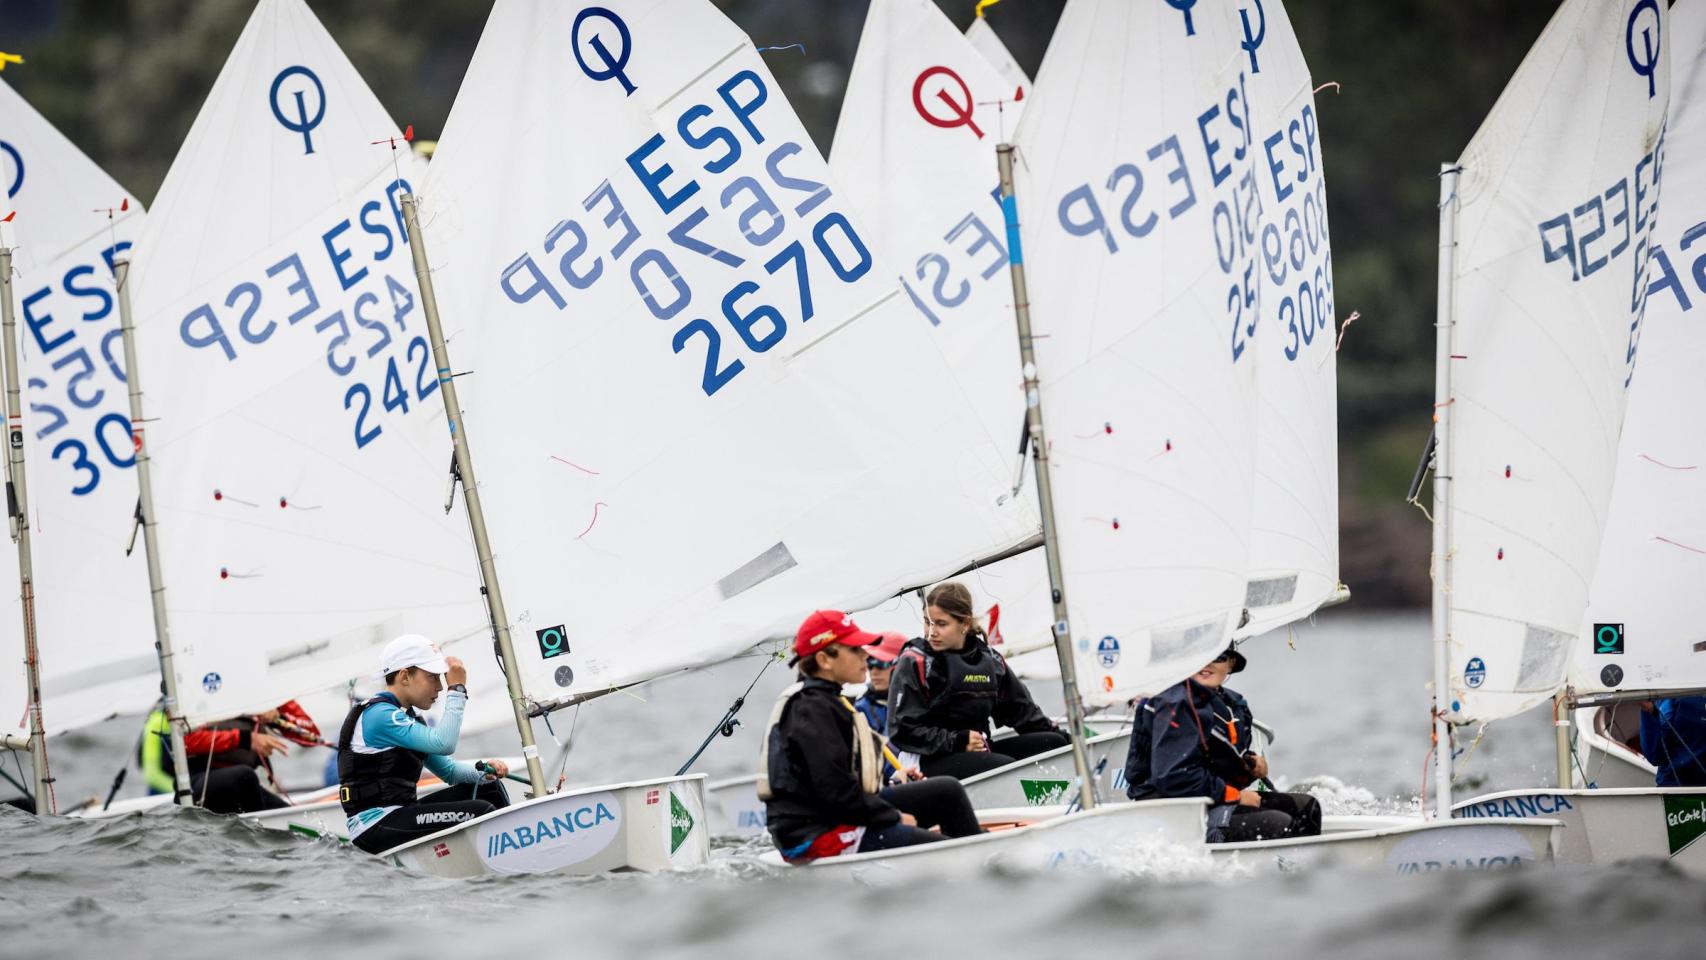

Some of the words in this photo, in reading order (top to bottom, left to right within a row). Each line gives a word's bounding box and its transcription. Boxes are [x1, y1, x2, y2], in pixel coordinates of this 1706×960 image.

[625, 70, 768, 215] ESP
[1263, 104, 1315, 202] ESP
[672, 212, 872, 397] 2670
